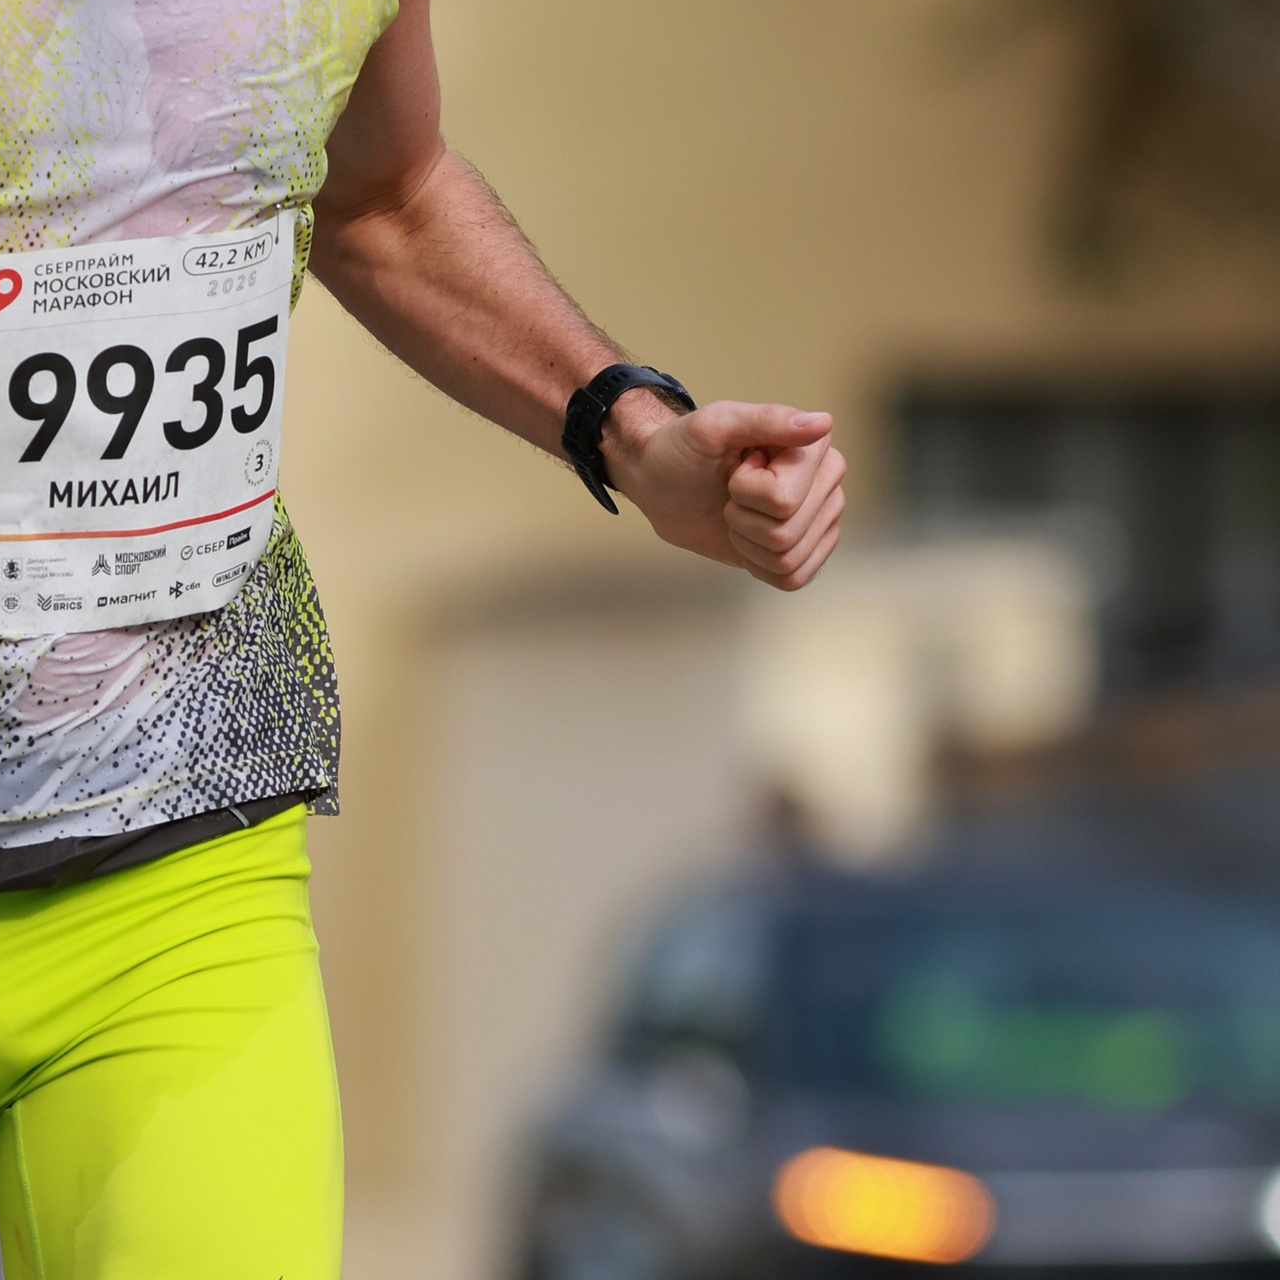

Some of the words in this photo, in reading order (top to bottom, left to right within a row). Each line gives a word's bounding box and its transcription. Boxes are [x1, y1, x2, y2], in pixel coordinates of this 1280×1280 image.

[34, 253, 134, 276] СБЕРПРАЙМ
[195, 248, 238, 269] 42,2
[244, 239, 266, 262] КМ
[33, 263, 171, 296] МОСКОВСКИЙ
[32, 288, 133, 314] МАРАФОН
[254, 453, 264, 472] 3
[48, 471, 180, 509] МИХАИЛ
[115, 544, 167, 564] МОСКОВСКИЙ
[196, 540, 225, 555] СБЕР
[115, 562, 141, 576] СПОРТ
[53, 601, 83, 612] BRICS
